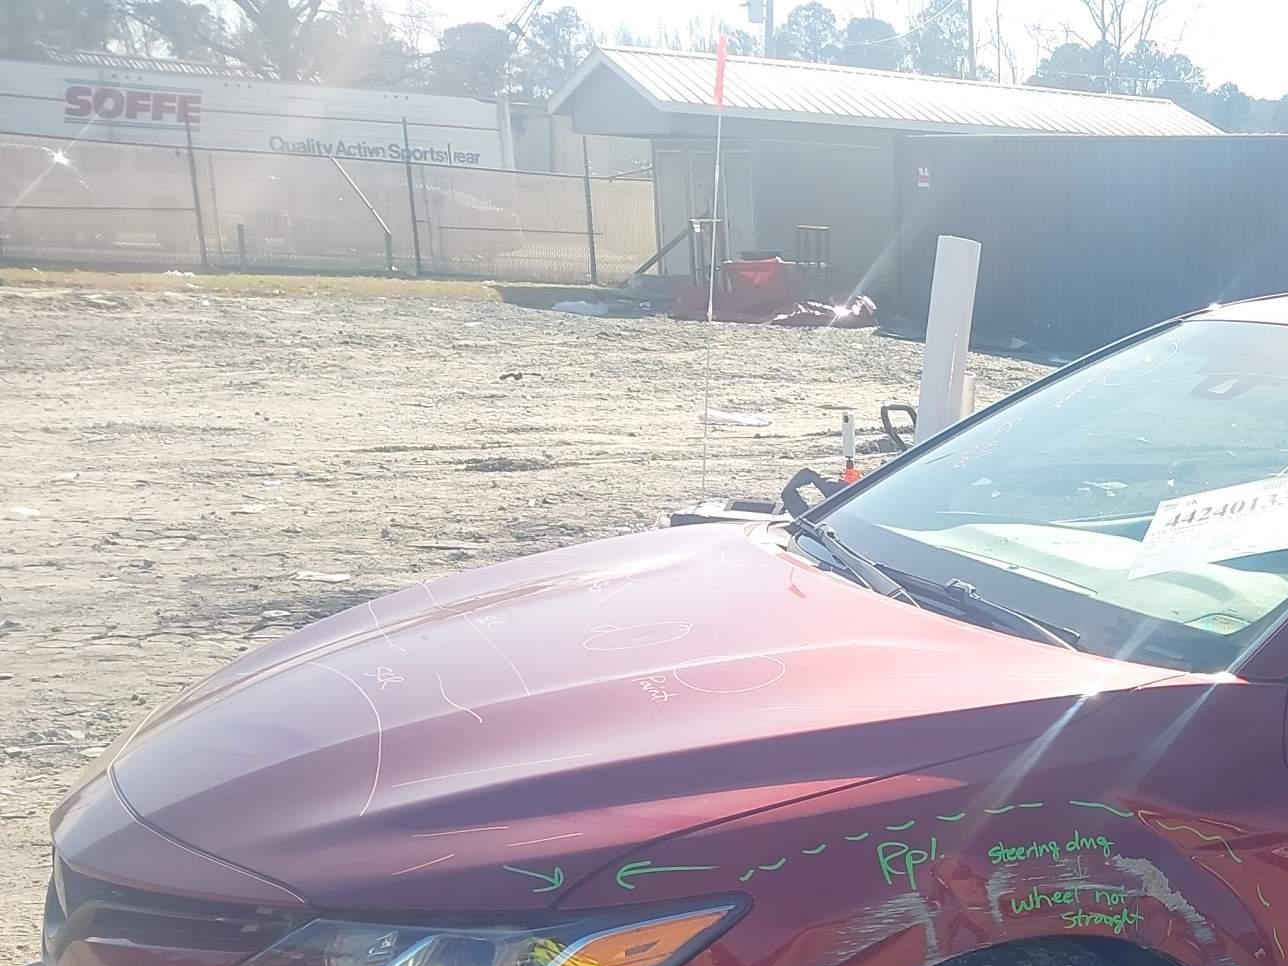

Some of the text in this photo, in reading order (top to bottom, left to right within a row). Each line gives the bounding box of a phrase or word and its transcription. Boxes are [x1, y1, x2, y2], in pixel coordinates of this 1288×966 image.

[64, 86, 202, 123] SOFFE
[269, 136, 333, 158] Quality
[987, 828, 1116, 865] steering dmg
[1010, 884, 1127, 914] wheel not
